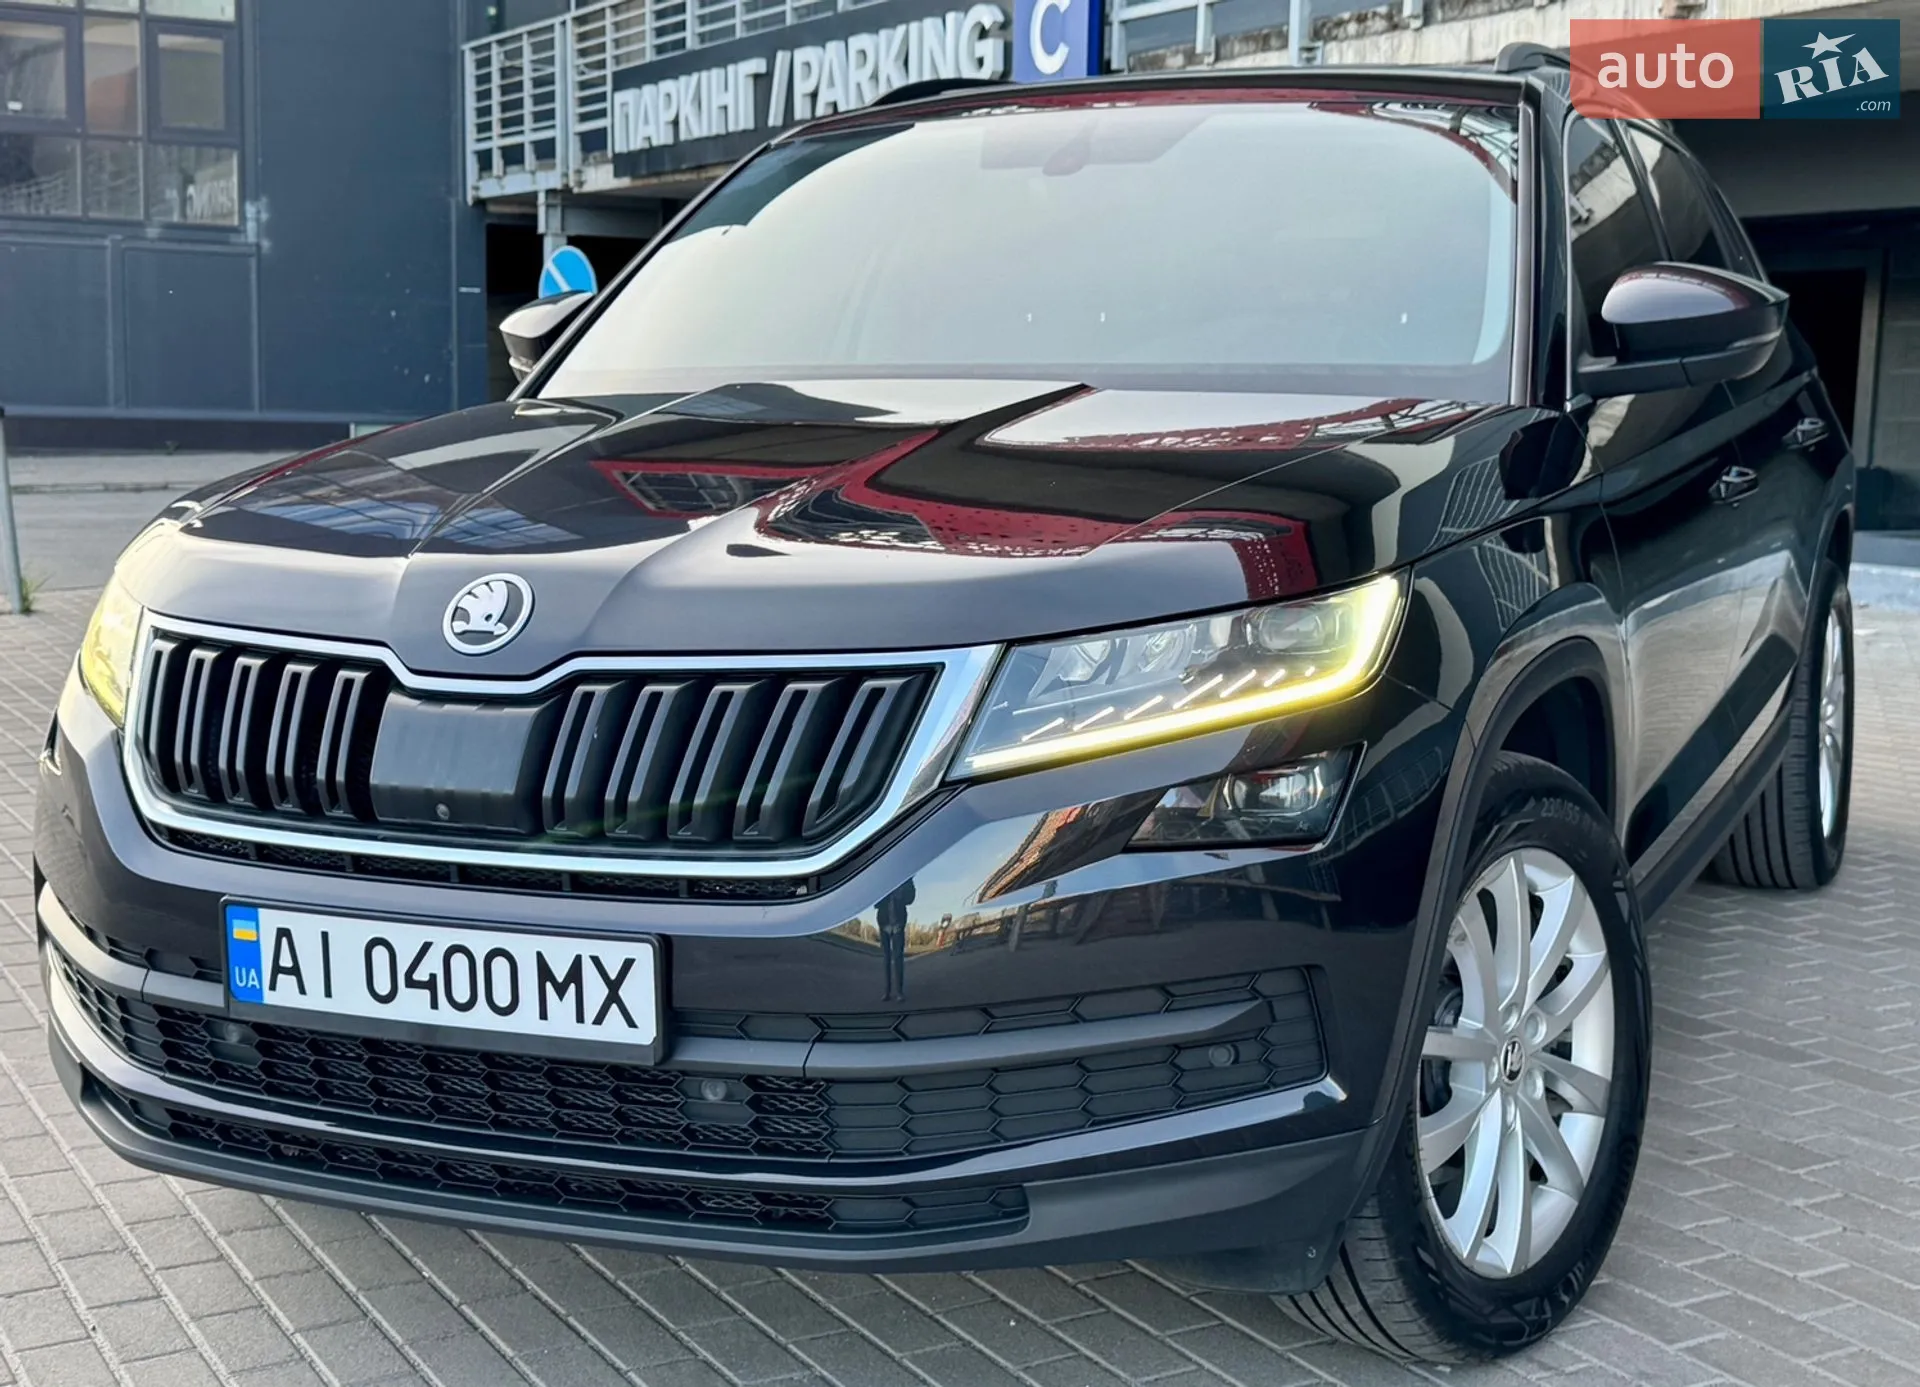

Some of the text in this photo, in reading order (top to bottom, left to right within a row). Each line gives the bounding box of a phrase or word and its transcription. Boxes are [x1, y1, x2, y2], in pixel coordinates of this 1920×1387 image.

[1029, 0, 1070, 75] C
[234, 966, 261, 990] UA
[268, 927, 639, 1029] AI 0400 MX
